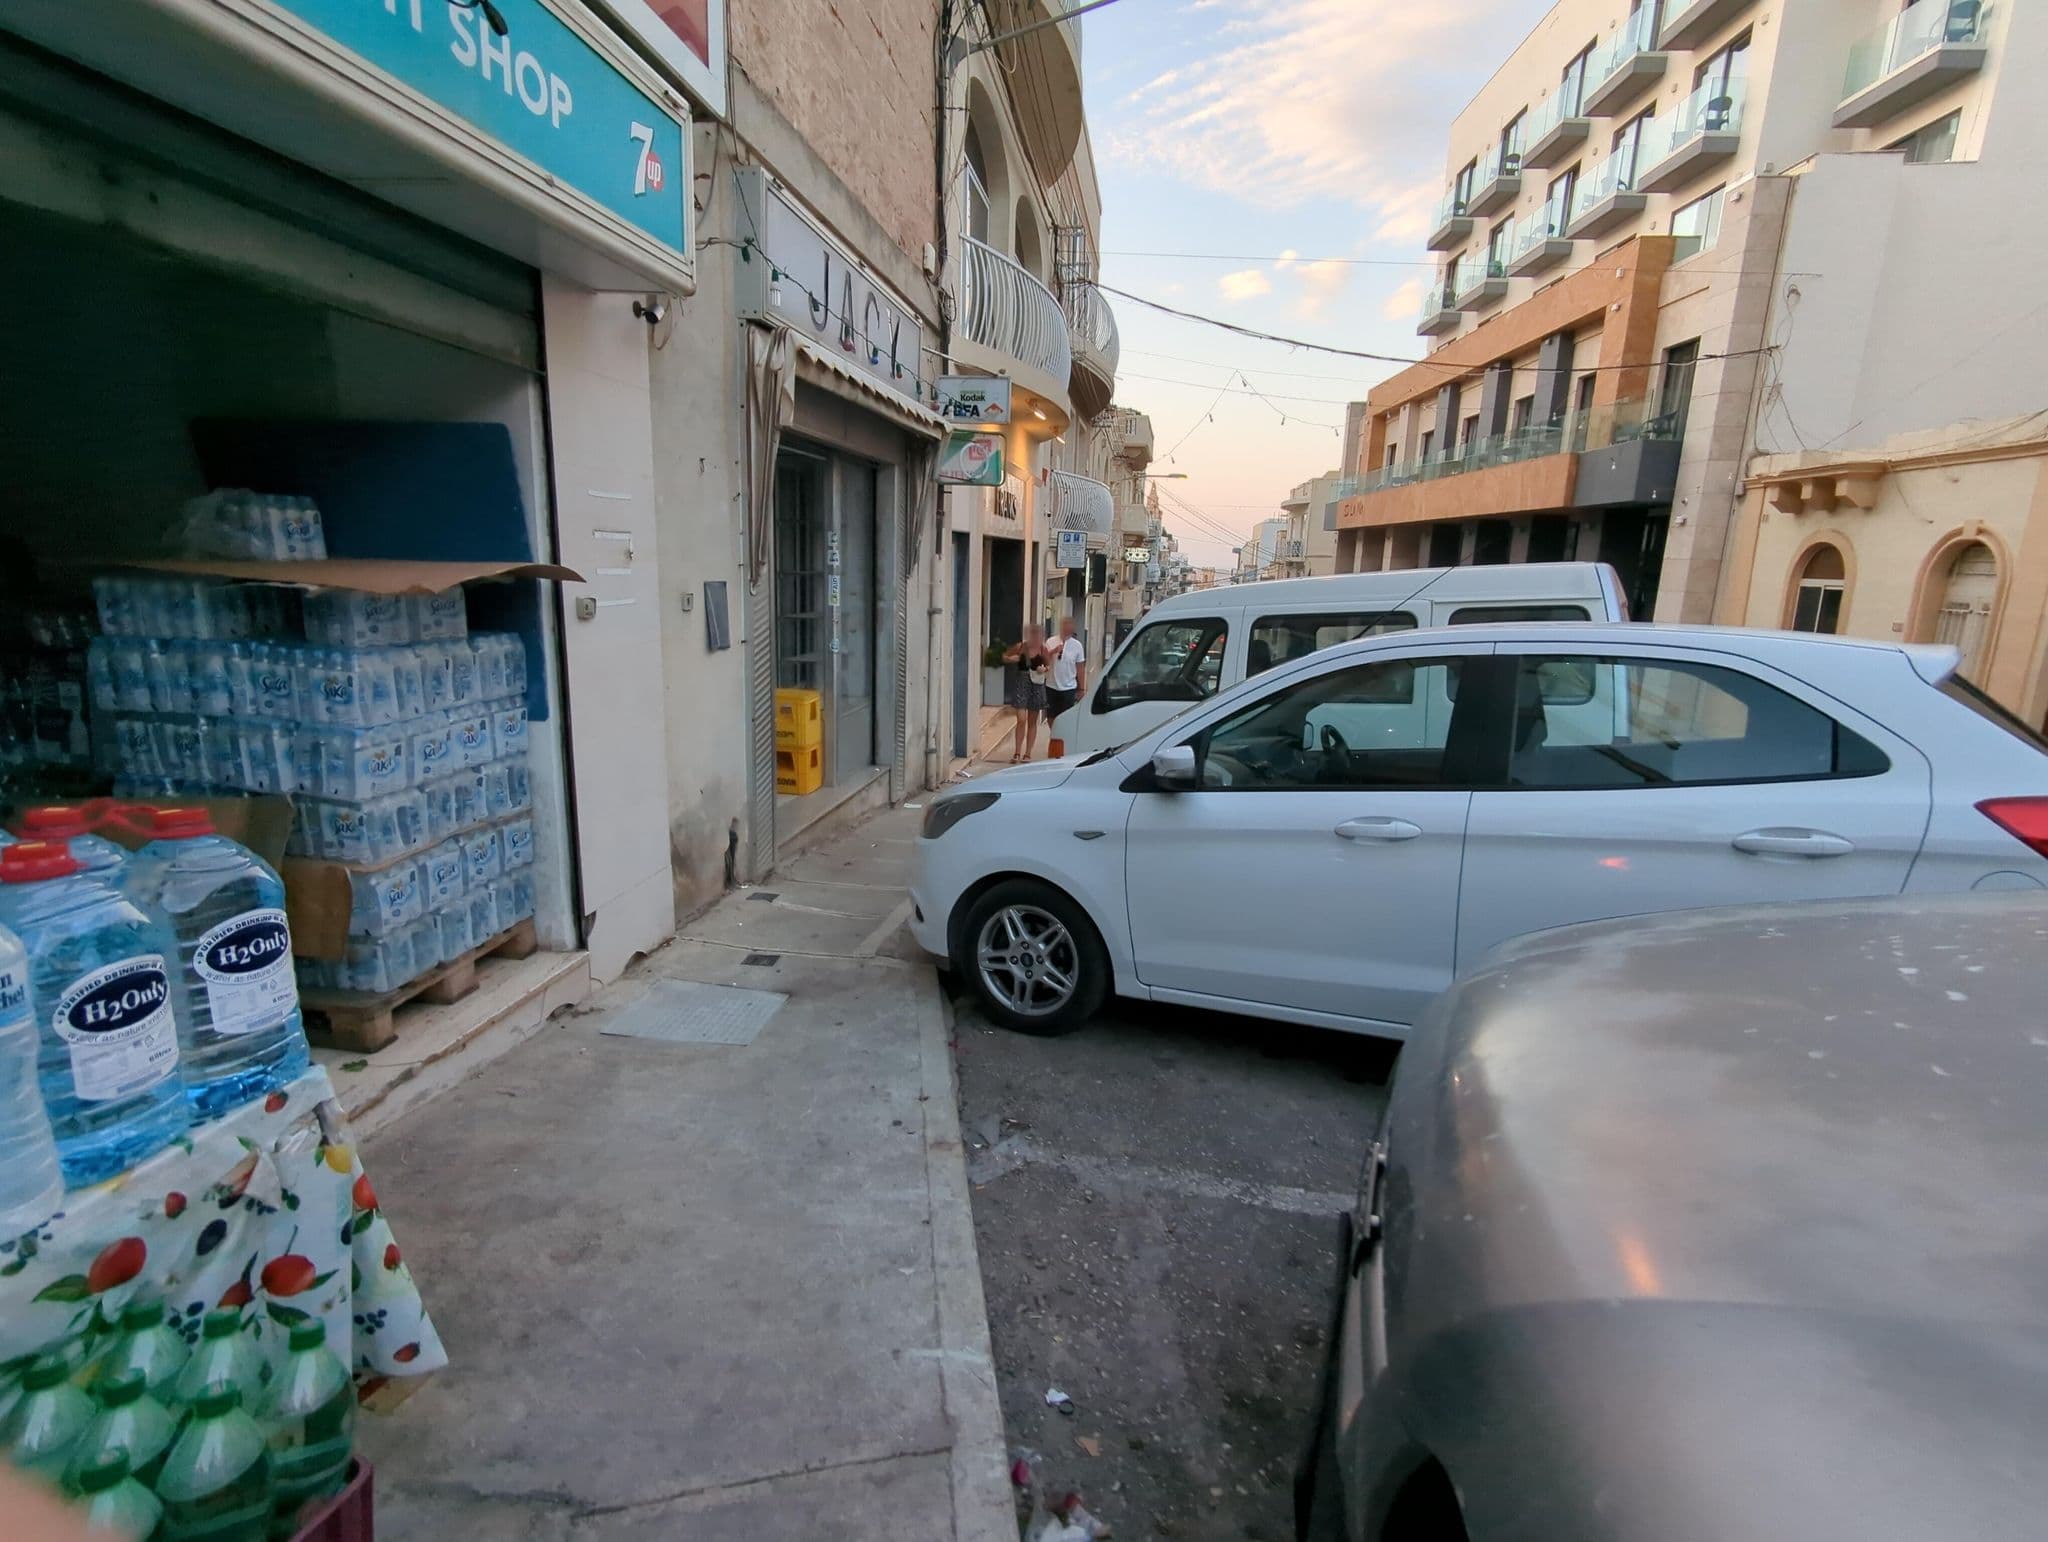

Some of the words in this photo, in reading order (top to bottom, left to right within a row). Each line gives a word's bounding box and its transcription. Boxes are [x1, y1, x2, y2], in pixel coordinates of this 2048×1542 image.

[449, 0, 573, 129] SHOP
[960, 393, 986, 401] Kodak
[217, 931, 288, 966] H2Only
[57, 979, 103, 1017] PURIFIED
[83, 980, 166, 1025] H2Only
